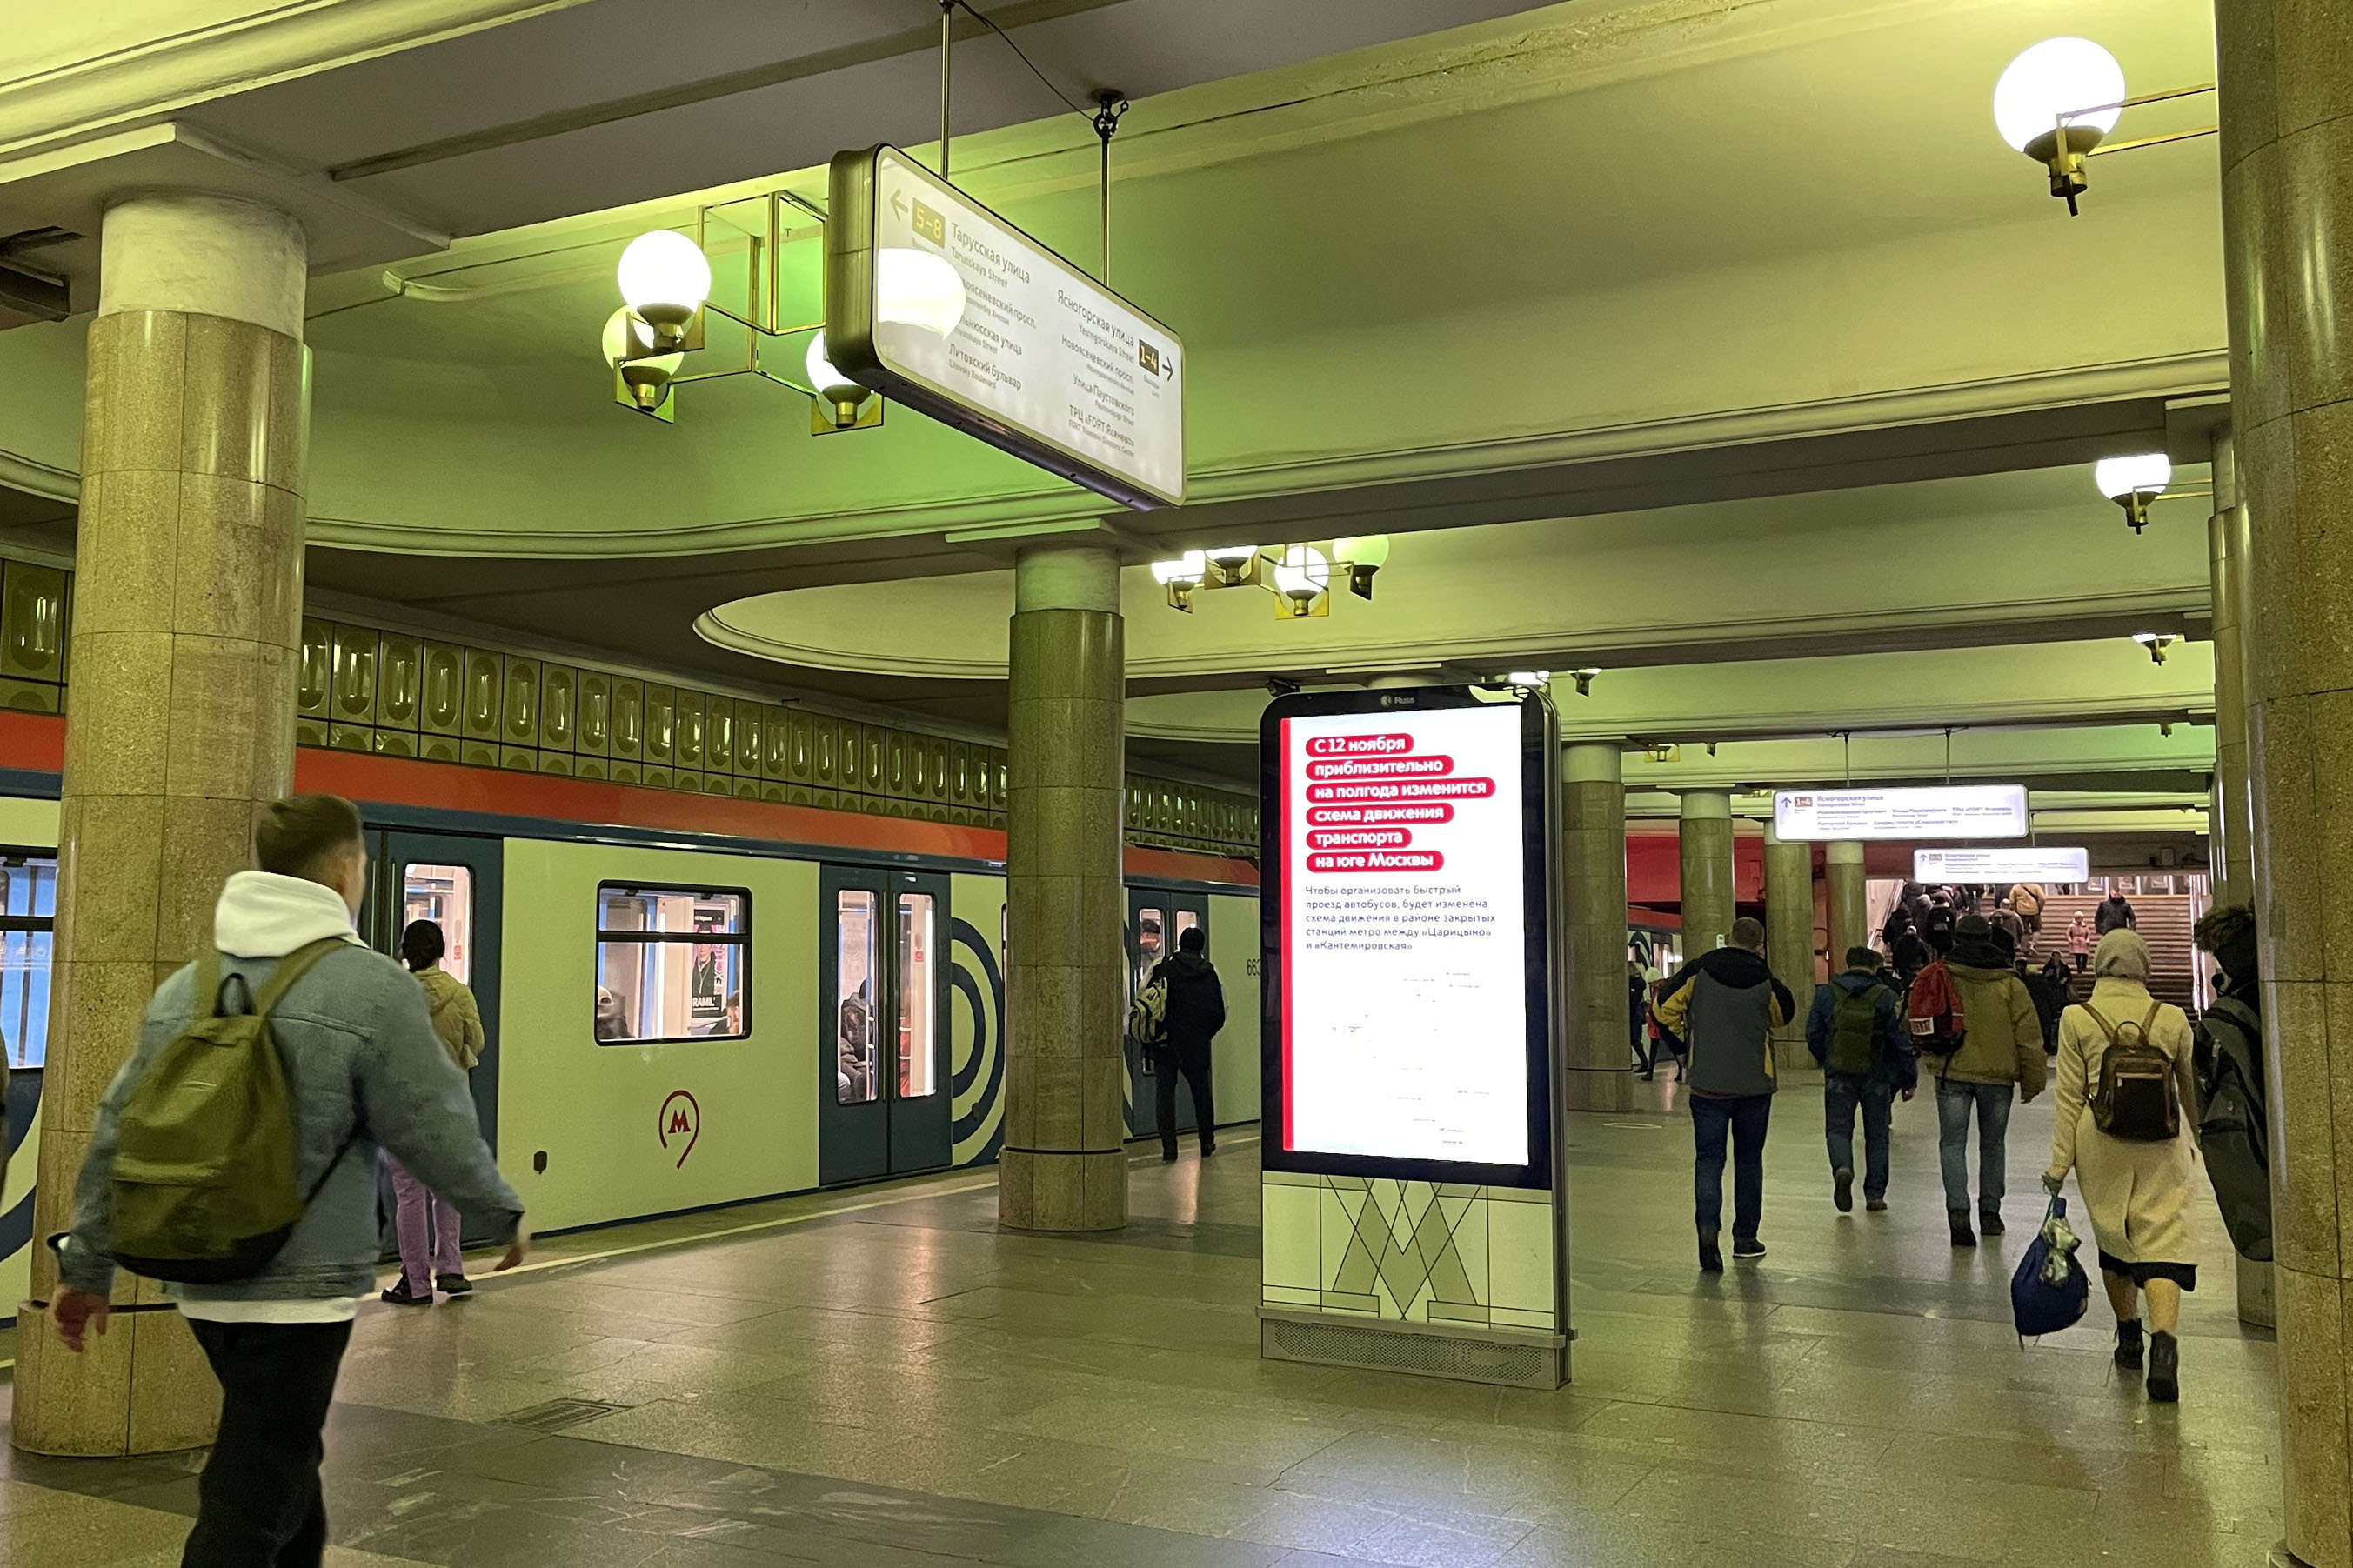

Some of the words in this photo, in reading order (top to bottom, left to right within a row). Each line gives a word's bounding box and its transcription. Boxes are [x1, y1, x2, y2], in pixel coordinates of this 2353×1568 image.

[952, 222, 1001, 266] Тарусская
[1002, 257, 1030, 284] улица
[988, 268, 1008, 289] Street
[961, 277, 1013, 316] воясеневский
[1013, 309, 1037, 330] просп.
[1058, 289, 1110, 332] Ясногорская
[1111, 324, 1134, 348] улица
[960, 314, 1000, 344] льнюсская
[1000, 336, 1022, 356] улица
[949, 343, 991, 374] Литовский
[992, 365, 1022, 391] бульвар
[1073, 373, 1093, 394] Улица
[1069, 404, 1084, 424] ТРЦ
[1327, 737, 1346, 753] 12
[1348, 736, 1406, 753] ноября
[1315, 759, 1443, 778] приблизительно
[1315, 787, 1333, 799] на
[1336, 784, 1399, 799] полгода
[1401, 780, 1487, 797] изменится
[1315, 809, 1361, 822] схема
[1364, 806, 1444, 823] движения
[1315, 831, 1403, 848] транспорта
[1315, 856, 1332, 868] на
[1336, 854, 1366, 868] юге
[1368, 851, 1434, 867] Москвы
[1414, 884, 1461, 896] быстрый
[1306, 901, 1341, 910] проезд
[1344, 899, 1400, 910] автобусов,
[1402, 899, 1433, 910] будет
[1402, 913, 1440, 923] районе
[1306, 928, 1346, 937] станций
[1384, 929, 1419, 938] между
[1422, 927, 1491, 937] «Царицыно»
[1314, 941, 1413, 951] «Кантемировская»
